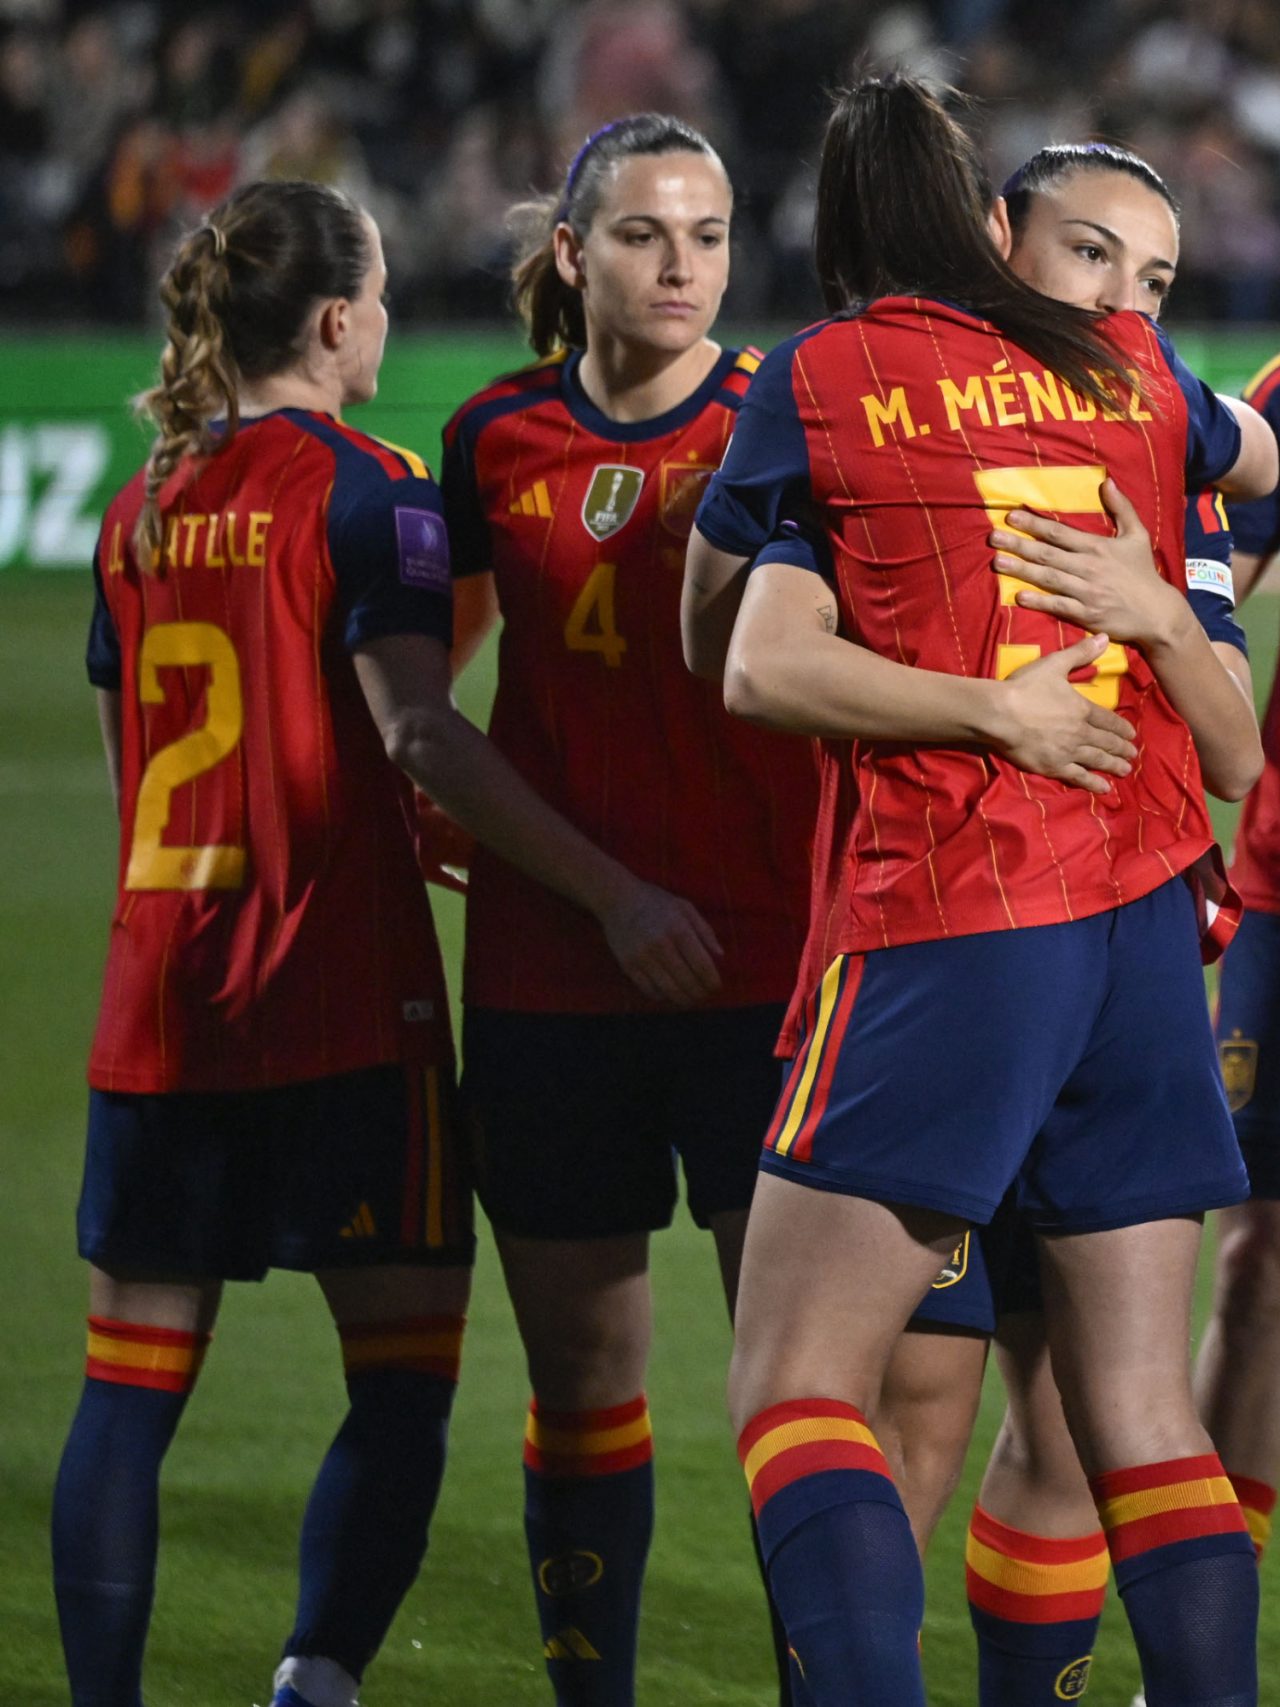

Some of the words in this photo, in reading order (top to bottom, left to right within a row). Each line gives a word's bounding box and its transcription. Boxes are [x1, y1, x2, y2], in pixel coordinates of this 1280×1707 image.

[860, 387, 931, 448] M.
[564, 562, 627, 668] 4
[125, 622, 244, 890] 2
